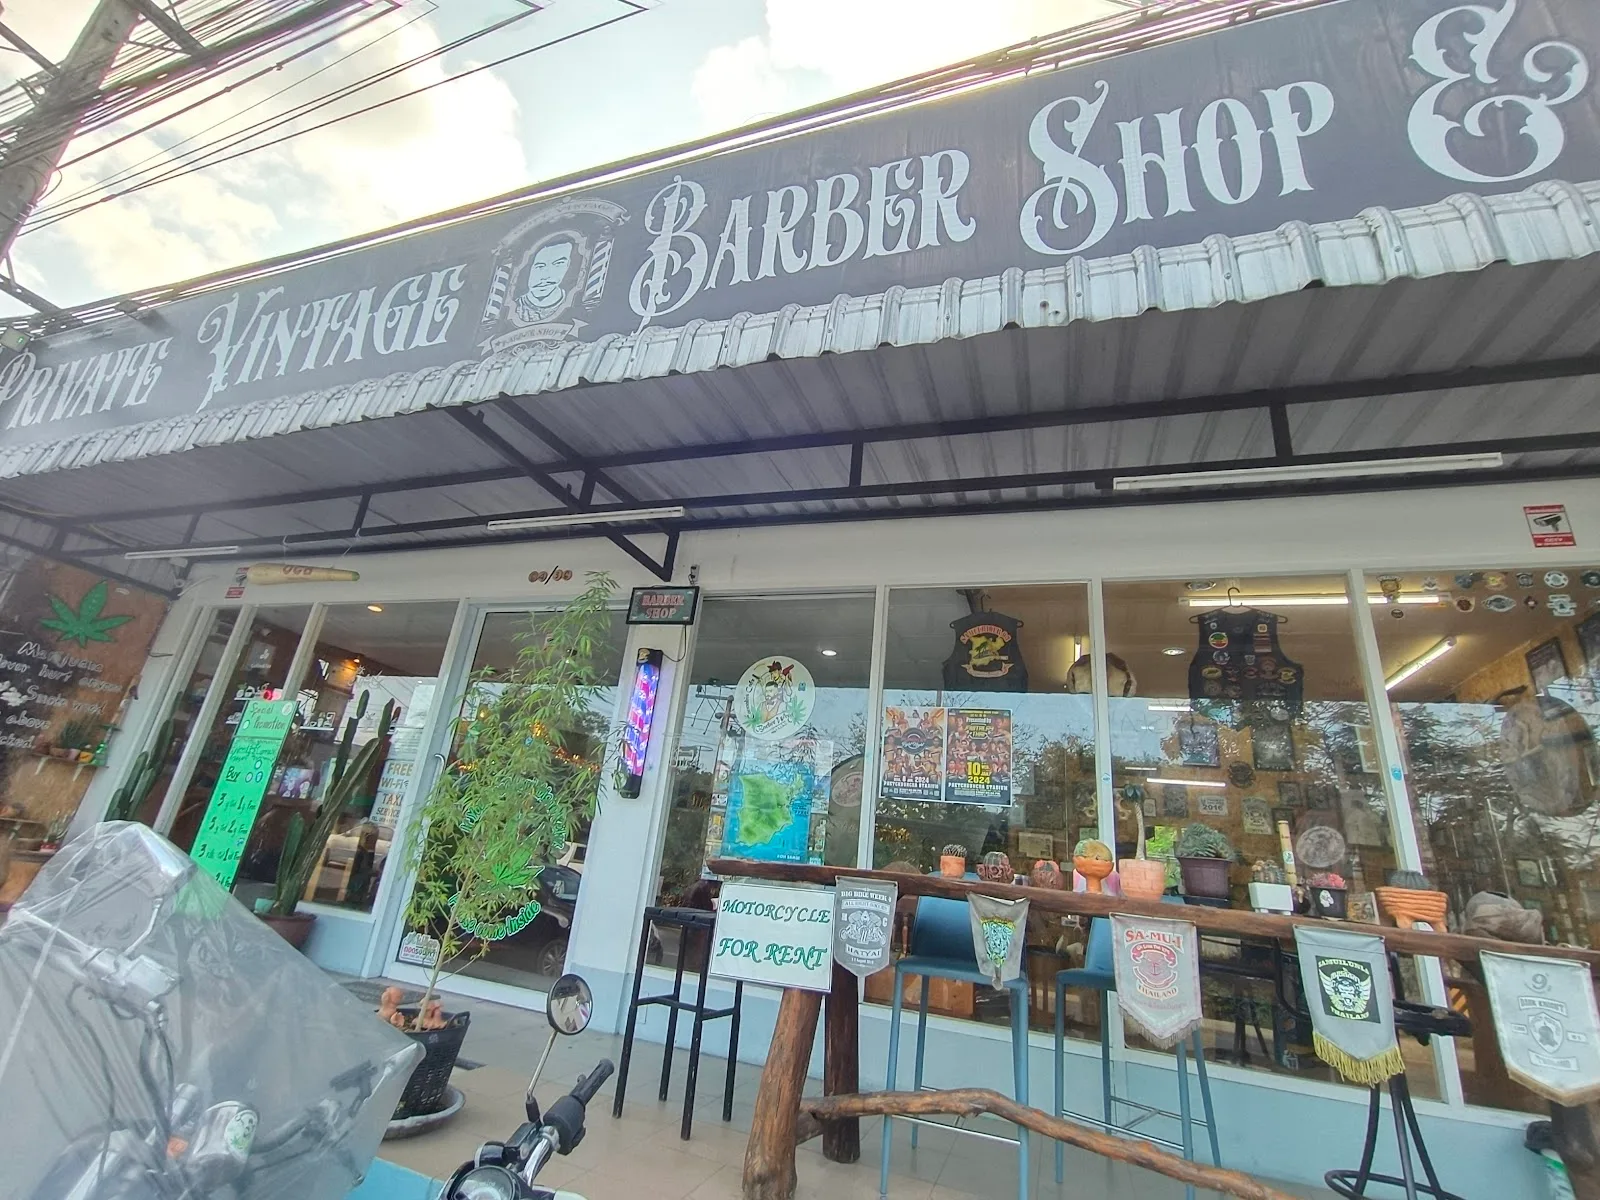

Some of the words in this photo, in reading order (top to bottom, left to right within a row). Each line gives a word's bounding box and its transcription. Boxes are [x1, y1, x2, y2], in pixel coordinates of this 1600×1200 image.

[629, 150, 976, 335] BARBER
[1020, 80, 1334, 256] SHOP
[1407, 0, 1588, 182] &
[0, 337, 174, 430] PRIVATE
[197, 264, 467, 413] VINTAGE
[645, 607, 677, 619] SHOP
[226, 765, 241, 781] Buy
[387, 762, 413, 777] FREE
[967, 761, 981, 776] 10
[381, 778, 404, 790] WI-FI
[968, 777, 990, 785] 2024
[382, 792, 405, 806] TAXI
[722, 899, 831, 924] MOTORCYCLE
[716, 938, 762, 963] FOR
[764, 943, 828, 970] RENT
[847, 946, 881, 957] HATYAI
